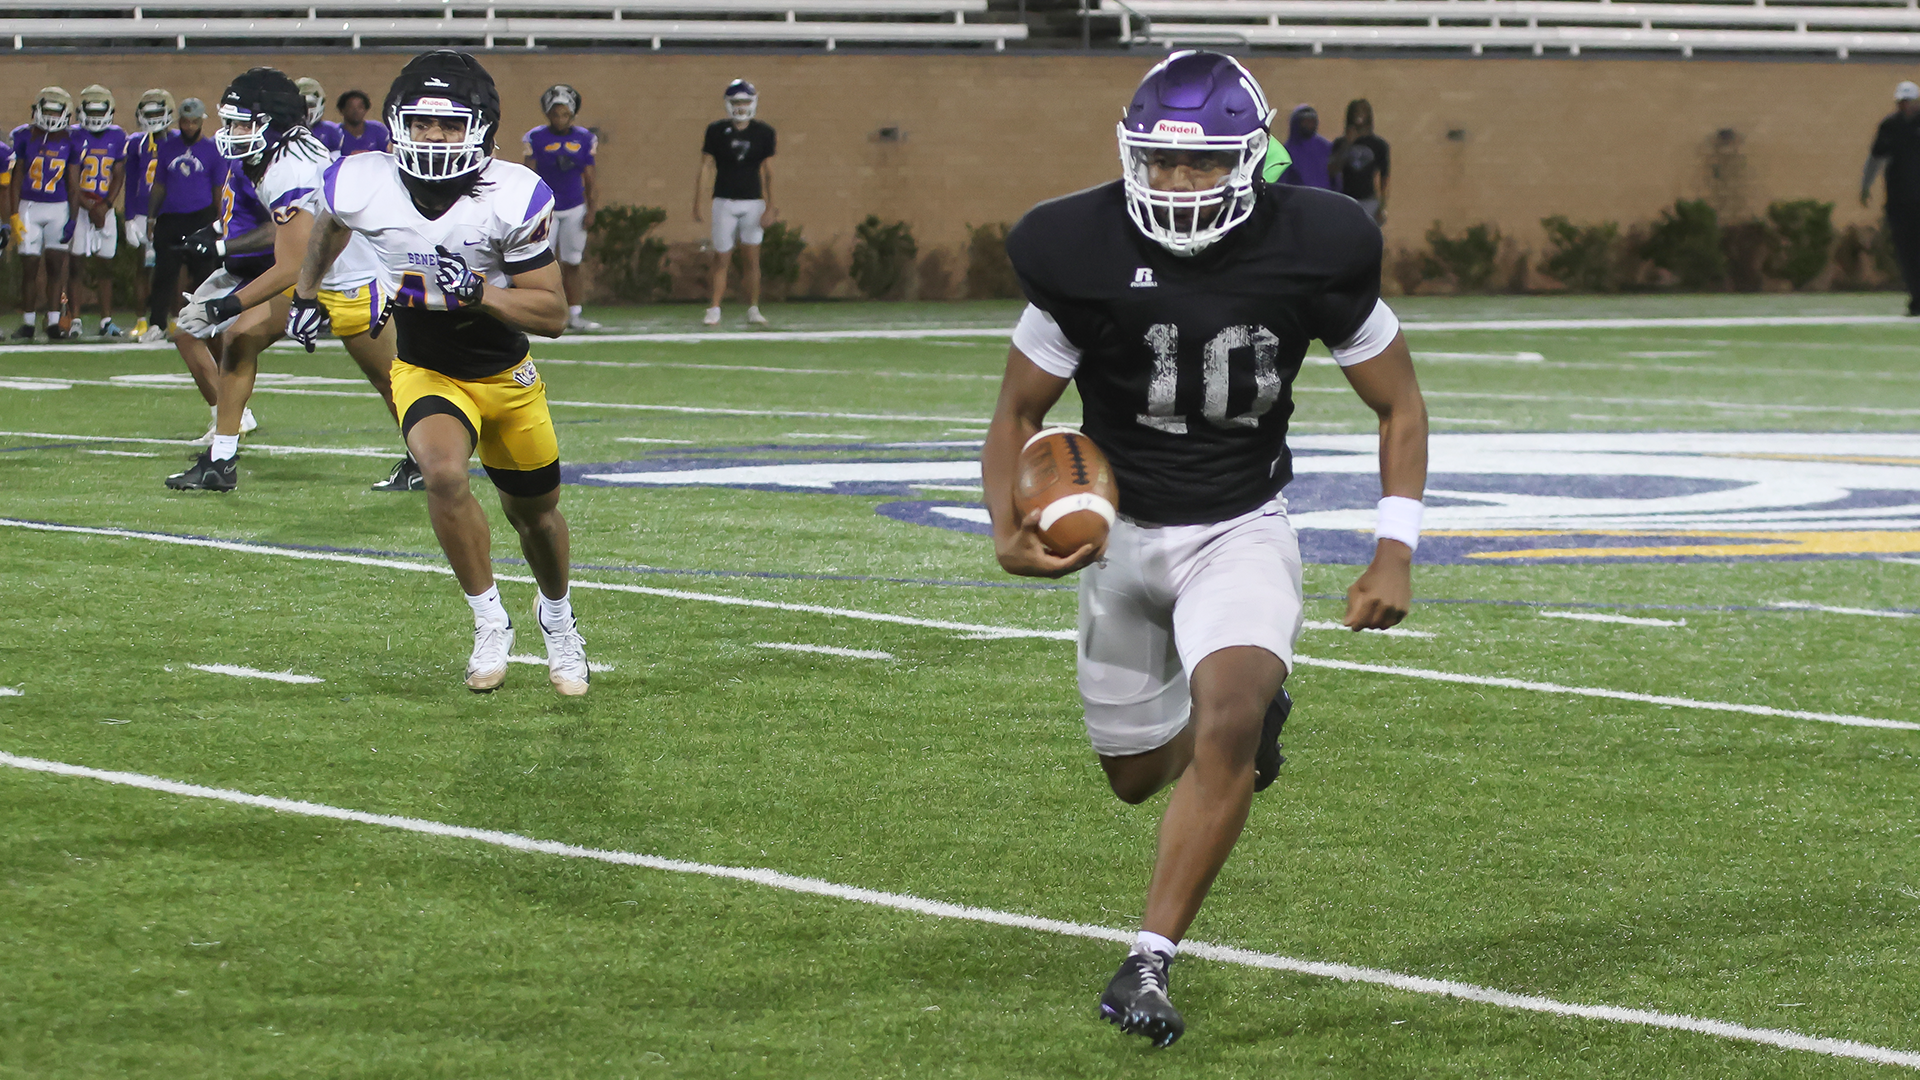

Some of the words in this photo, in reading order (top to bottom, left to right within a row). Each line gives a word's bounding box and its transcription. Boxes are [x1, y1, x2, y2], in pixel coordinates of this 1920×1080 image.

[1159, 123, 1198, 135] Riddell
[28, 156, 66, 193] 47
[80, 155, 115, 193] 25
[1136, 323, 1282, 434] 10
